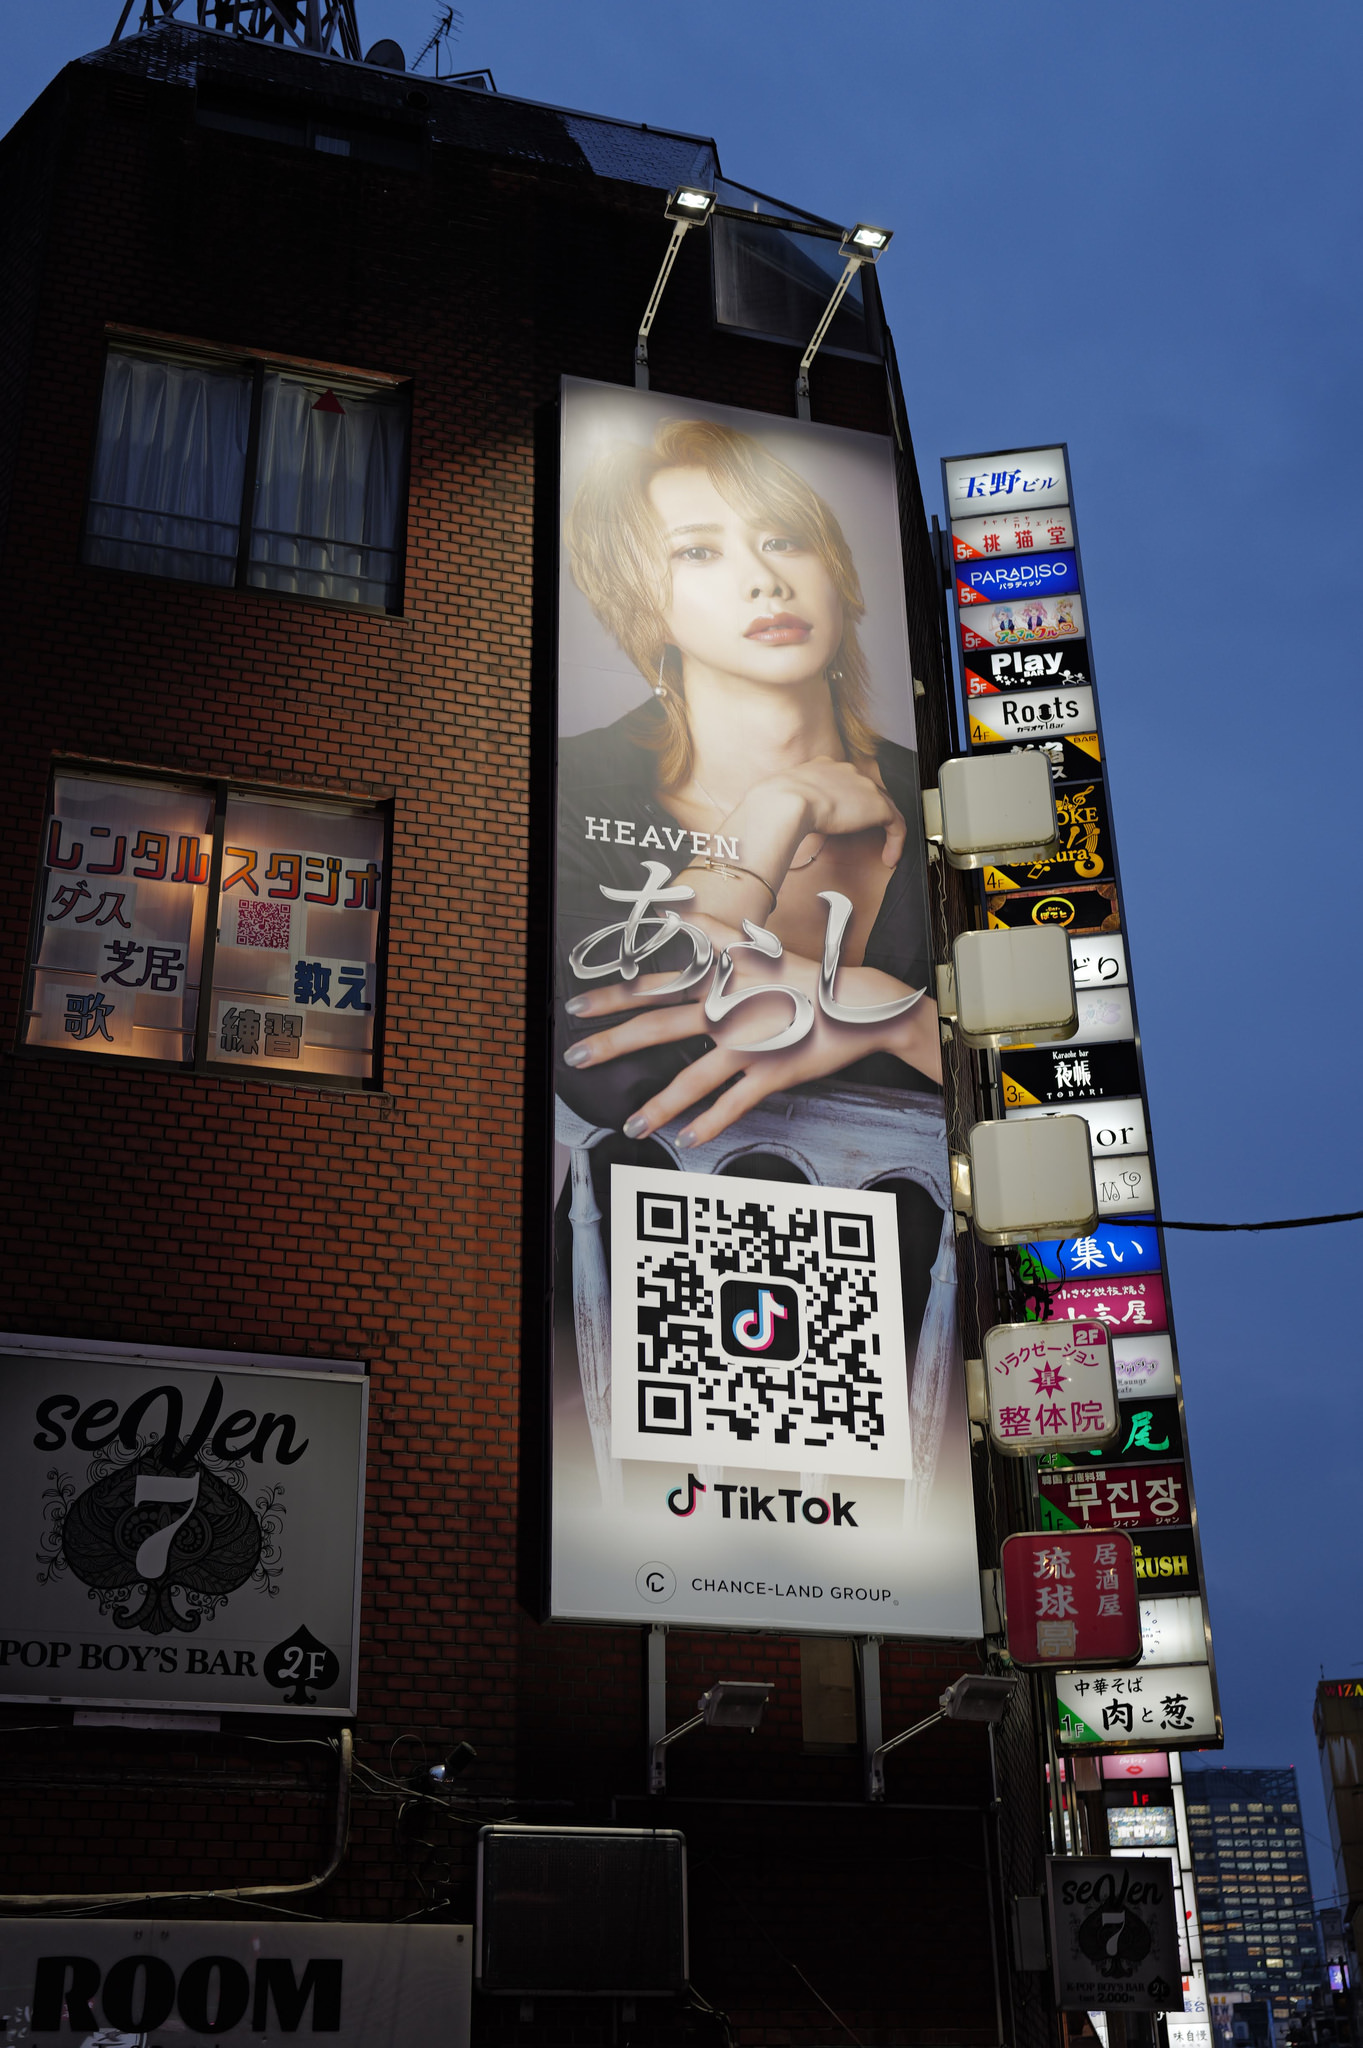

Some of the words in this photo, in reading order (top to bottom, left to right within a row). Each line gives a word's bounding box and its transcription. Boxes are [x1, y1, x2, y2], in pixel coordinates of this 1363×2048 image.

[955, 469, 1060, 500] 玉野ビル
[957, 544, 973, 560] 5F
[983, 526, 1067, 552] 桃猫堂
[970, 562, 1068, 586] PARADISO
[999, 579, 1042, 590] パラディッソ
[961, 588, 977, 604] 5F
[965, 632, 982, 649] 5F
[990, 651, 1064, 676] Play
[1023, 669, 1044, 678] BAR
[970, 678, 987, 694] 5F
[972, 725, 990, 741] 4F
[1073, 735, 1097, 743] BAR
[585, 815, 740, 861] HEAVEN
[46, 819, 210, 885] レンタル
[222, 845, 381, 911] スタジオ
[986, 872, 1005, 889] 4F
[47, 880, 132, 929] ダンス
[100, 939, 185, 993] 芝居
[568, 860, 928, 1052] あらし
[293, 960, 372, 1012] 教え
[64, 991, 115, 1042] 歌
[219, 1007, 304, 1059] 練習
[1052, 1050, 1077, 1060] Karaoke
[1078, 1049, 1089, 1058] bar
[1054, 1060, 1092, 1089] 夜帳
[1006, 1085, 1025, 1103] 3F
[1046, 1088, 1104, 1100] TOBARI
[1057, 1283, 1146, 1300] 小さな鉄板焼き
[1075, 1328, 1099, 1345] 2F
[994, 1340, 1099, 1376] リラクゼーション
[999, 1400, 1105, 1438] 整体院
[713, 1484, 860, 1528] TikTok
[1067, 1476, 1182, 1521] 무진장
[135, 1471, 200, 1579] 7
[1044, 1510, 1064, 1531] 1F
[691, 1578, 824, 1599] CHANCE-LAND
[830, 1586, 892, 1602] GROUP
[1093, 1543, 1123, 1617] 居酒屋
[78, 1643, 178, 1674] BOY'S
[185, 1648, 259, 1678] BAR
[277, 1645, 329, 1682] 2F
[1074, 1676, 1143, 1697] 中華そば
[1061, 1714, 1085, 1738] 1F
[1102, 1693, 1195, 1733] 肉と葱
[1101, 1909, 1126, 1957] 7
[31, 1955, 343, 2034] ROOM
